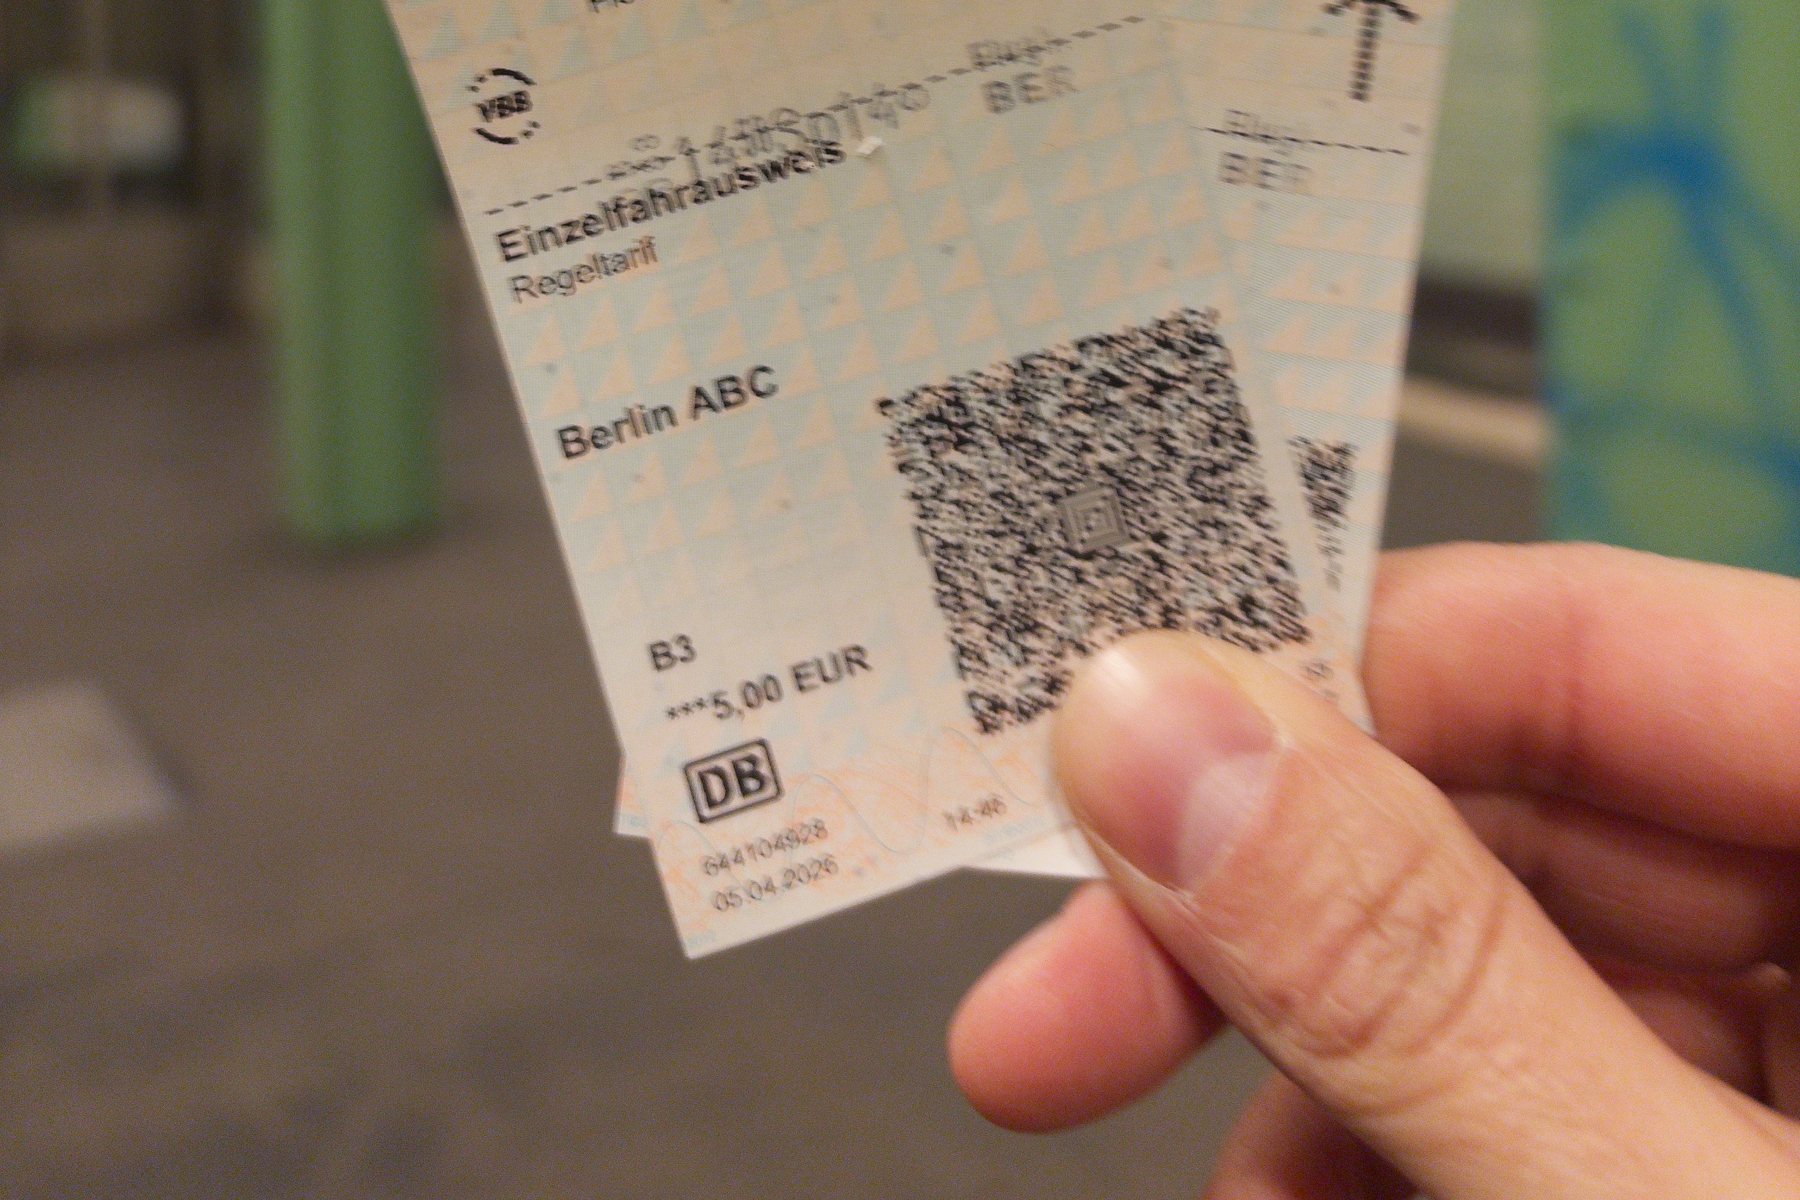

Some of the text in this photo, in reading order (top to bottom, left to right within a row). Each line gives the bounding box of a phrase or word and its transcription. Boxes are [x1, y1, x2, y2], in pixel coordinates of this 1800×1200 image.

[474, 90, 533, 123] VBB
[980, 64, 1080, 114] BER
[496, 139, 847, 262] Einzelfahrausweis
[510, 235, 659, 302] Regeltarif
[557, 364, 780, 460] Berlin ABC
[648, 633, 697, 672] B3
[790, 644, 873, 693] EUR
[696, 750, 770, 811] DB
[712, 852, 840, 912] 05.04.2026
